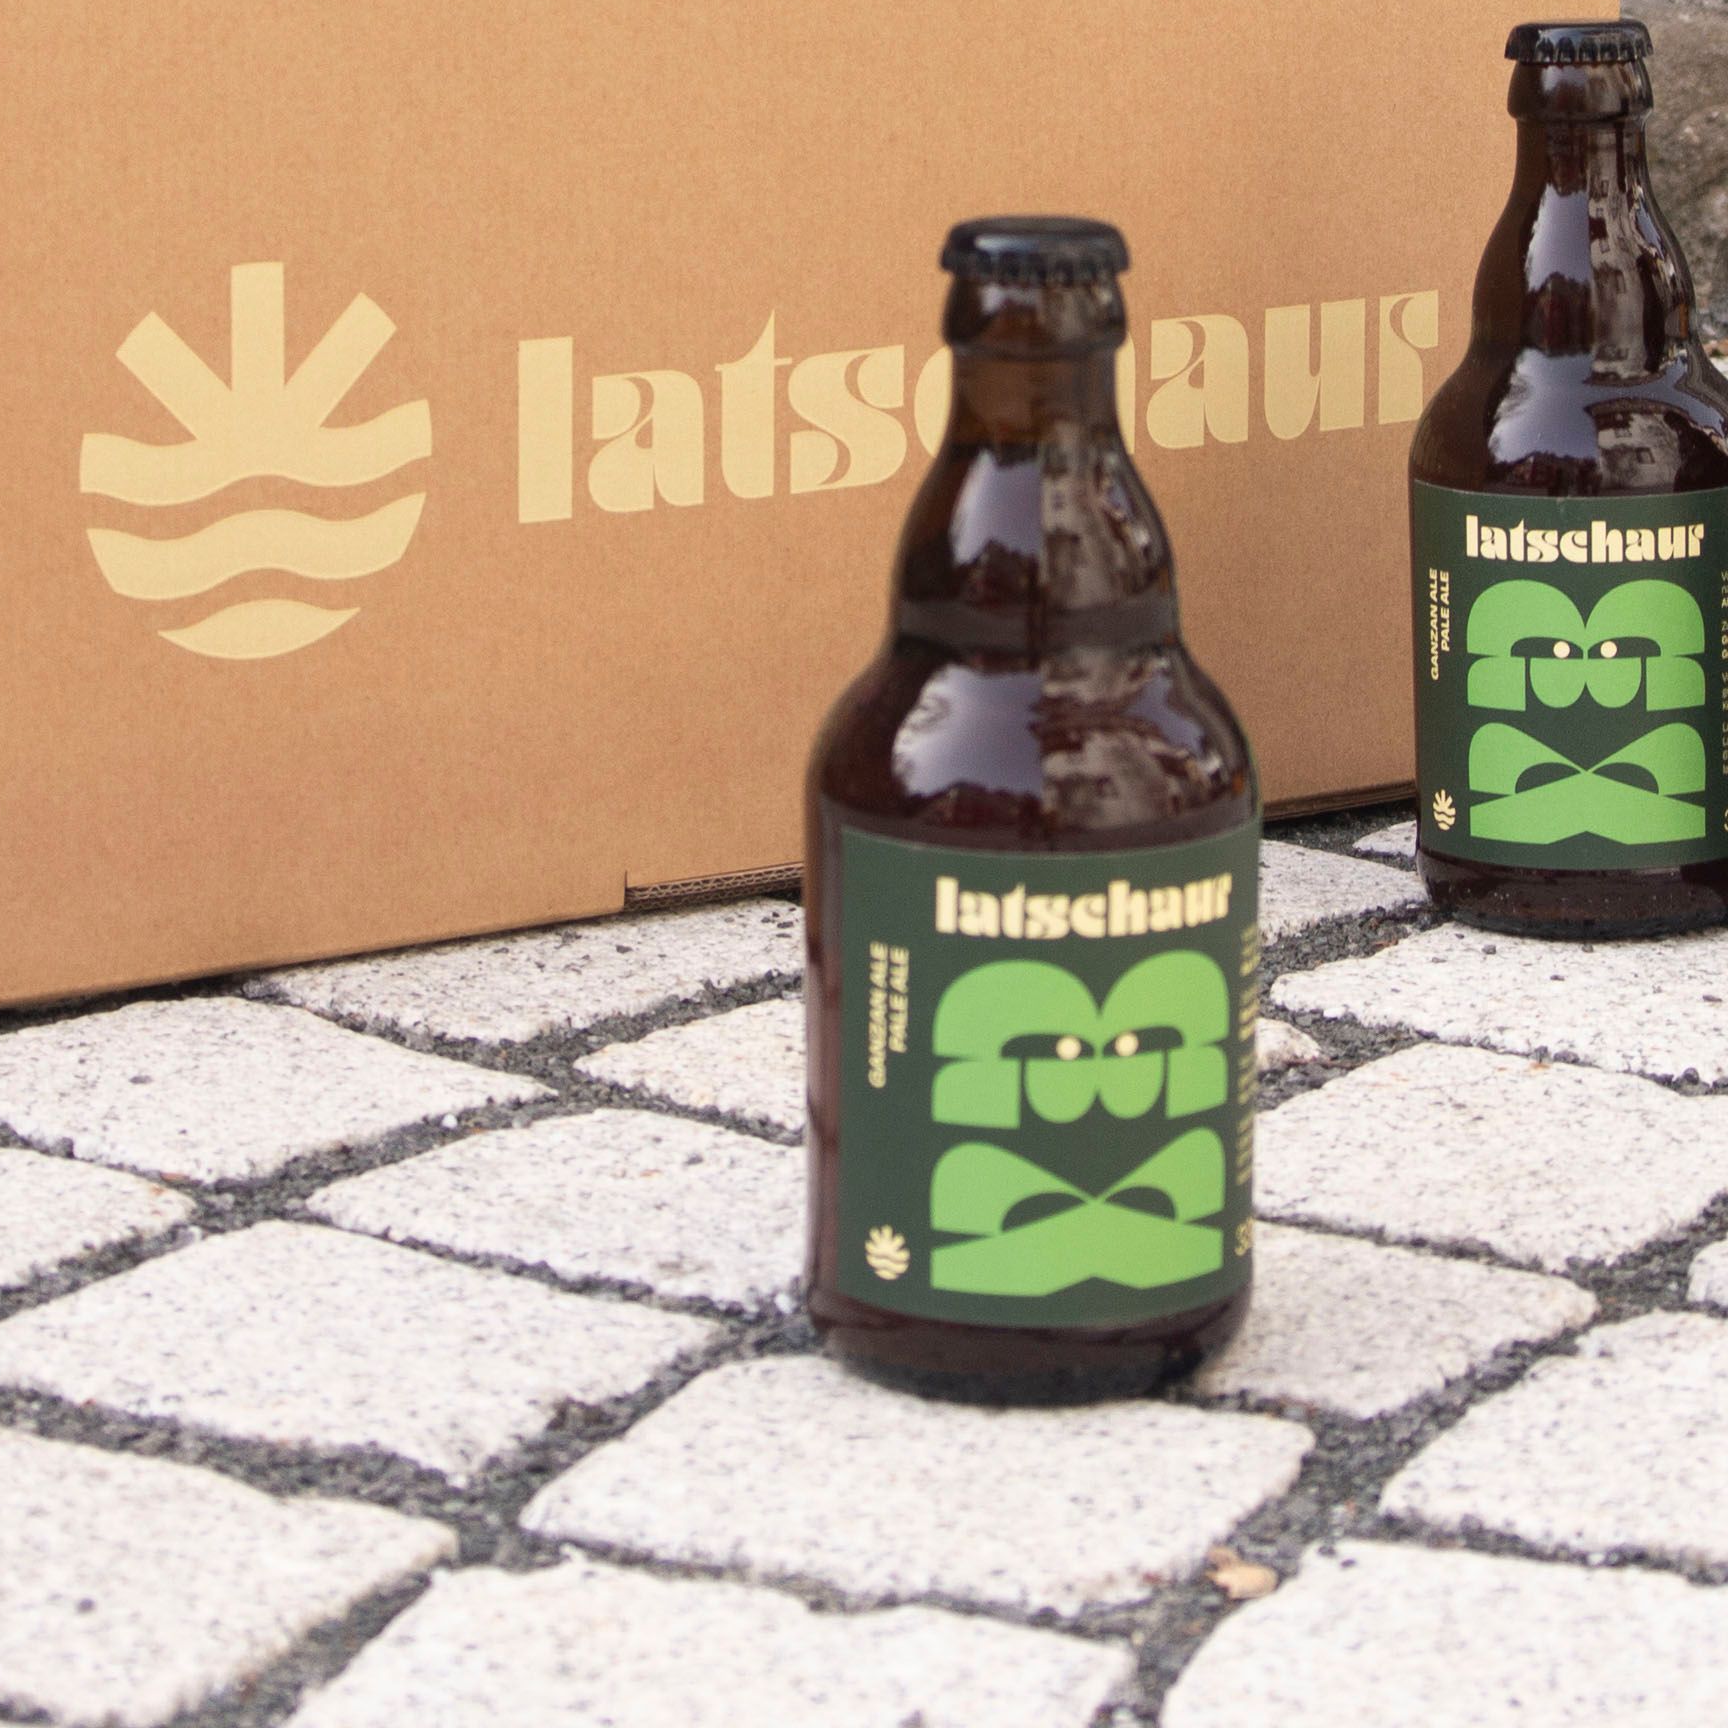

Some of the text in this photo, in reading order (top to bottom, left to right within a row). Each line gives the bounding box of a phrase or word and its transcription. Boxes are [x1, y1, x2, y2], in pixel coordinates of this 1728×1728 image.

[518, 308, 1438, 524] latsaur
[1466, 515, 1705, 563] latschaur
[1429, 567, 1439, 681] GANZAN ALE
[1440, 570, 1450, 652] PALE ALE
[935, 873, 1232, 939] latschaur
[888, 945, 909, 1054] PALE ALE
